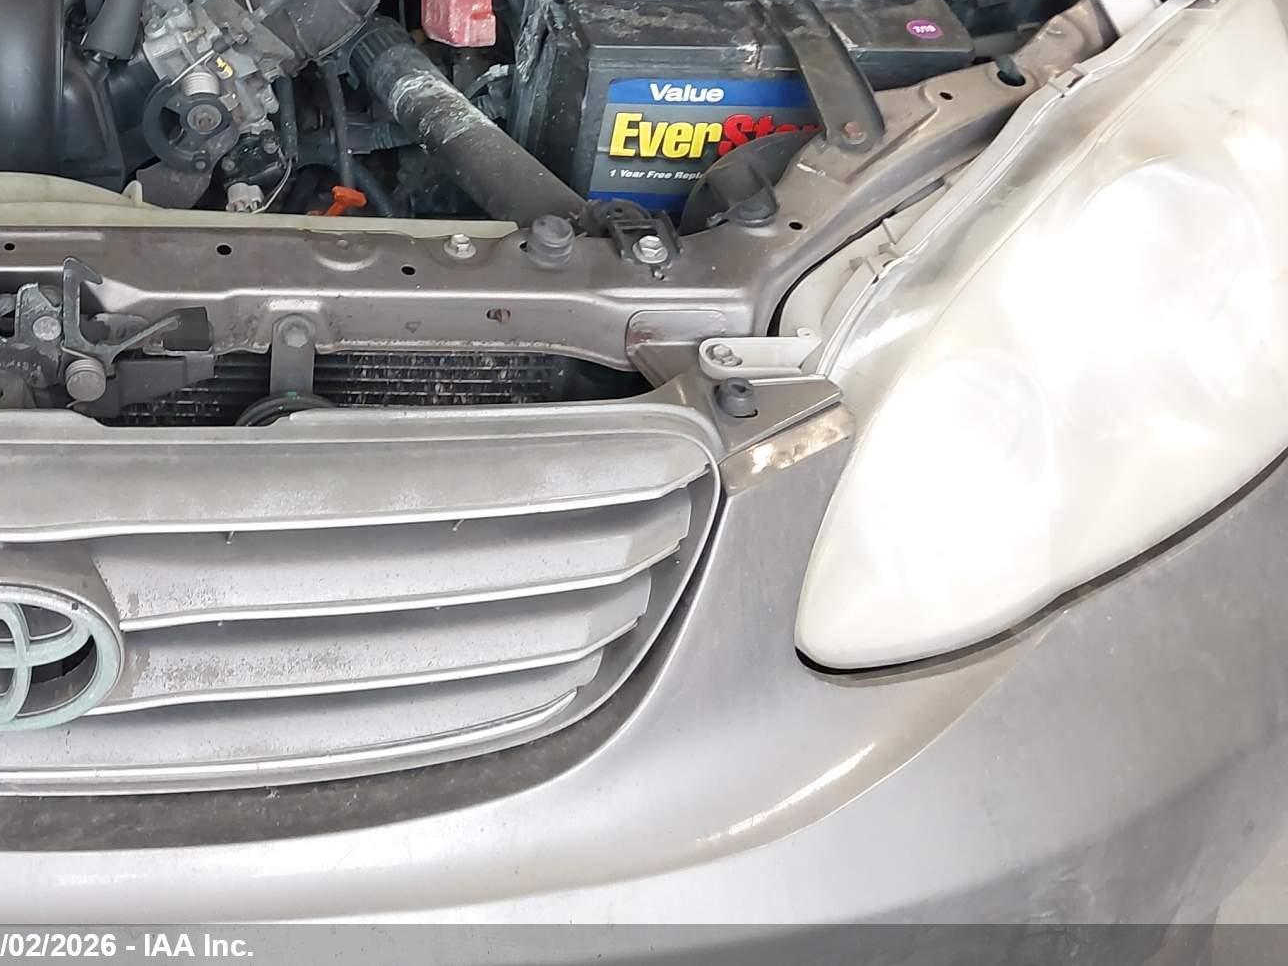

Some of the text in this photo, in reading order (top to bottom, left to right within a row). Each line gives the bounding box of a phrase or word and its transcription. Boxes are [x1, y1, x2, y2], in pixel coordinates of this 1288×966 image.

[649, 83, 724, 103] Value
[609, 169, 616, 178] 1
[620, 169, 645, 179] Year
[646, 170, 672, 180] Free
